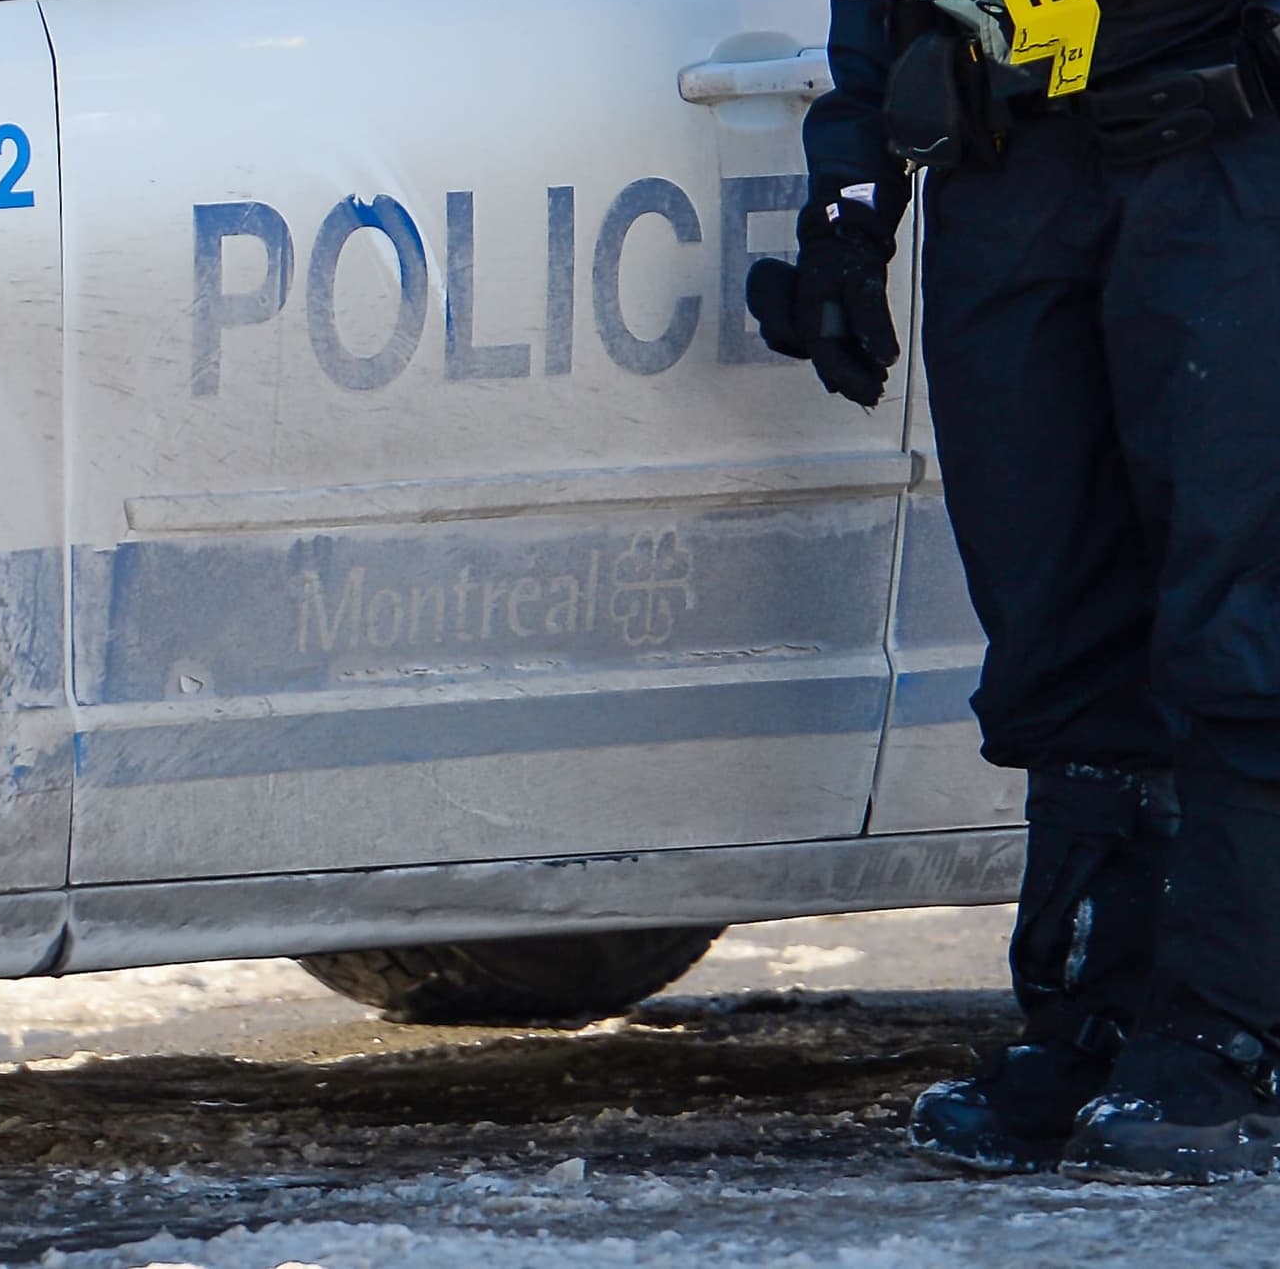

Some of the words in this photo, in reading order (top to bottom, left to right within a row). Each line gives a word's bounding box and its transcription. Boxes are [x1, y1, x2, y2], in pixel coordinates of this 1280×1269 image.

[1068, 47, 1083, 62] 12
[192, 173, 812, 396] POLICE
[297, 548, 602, 653] Montréal
